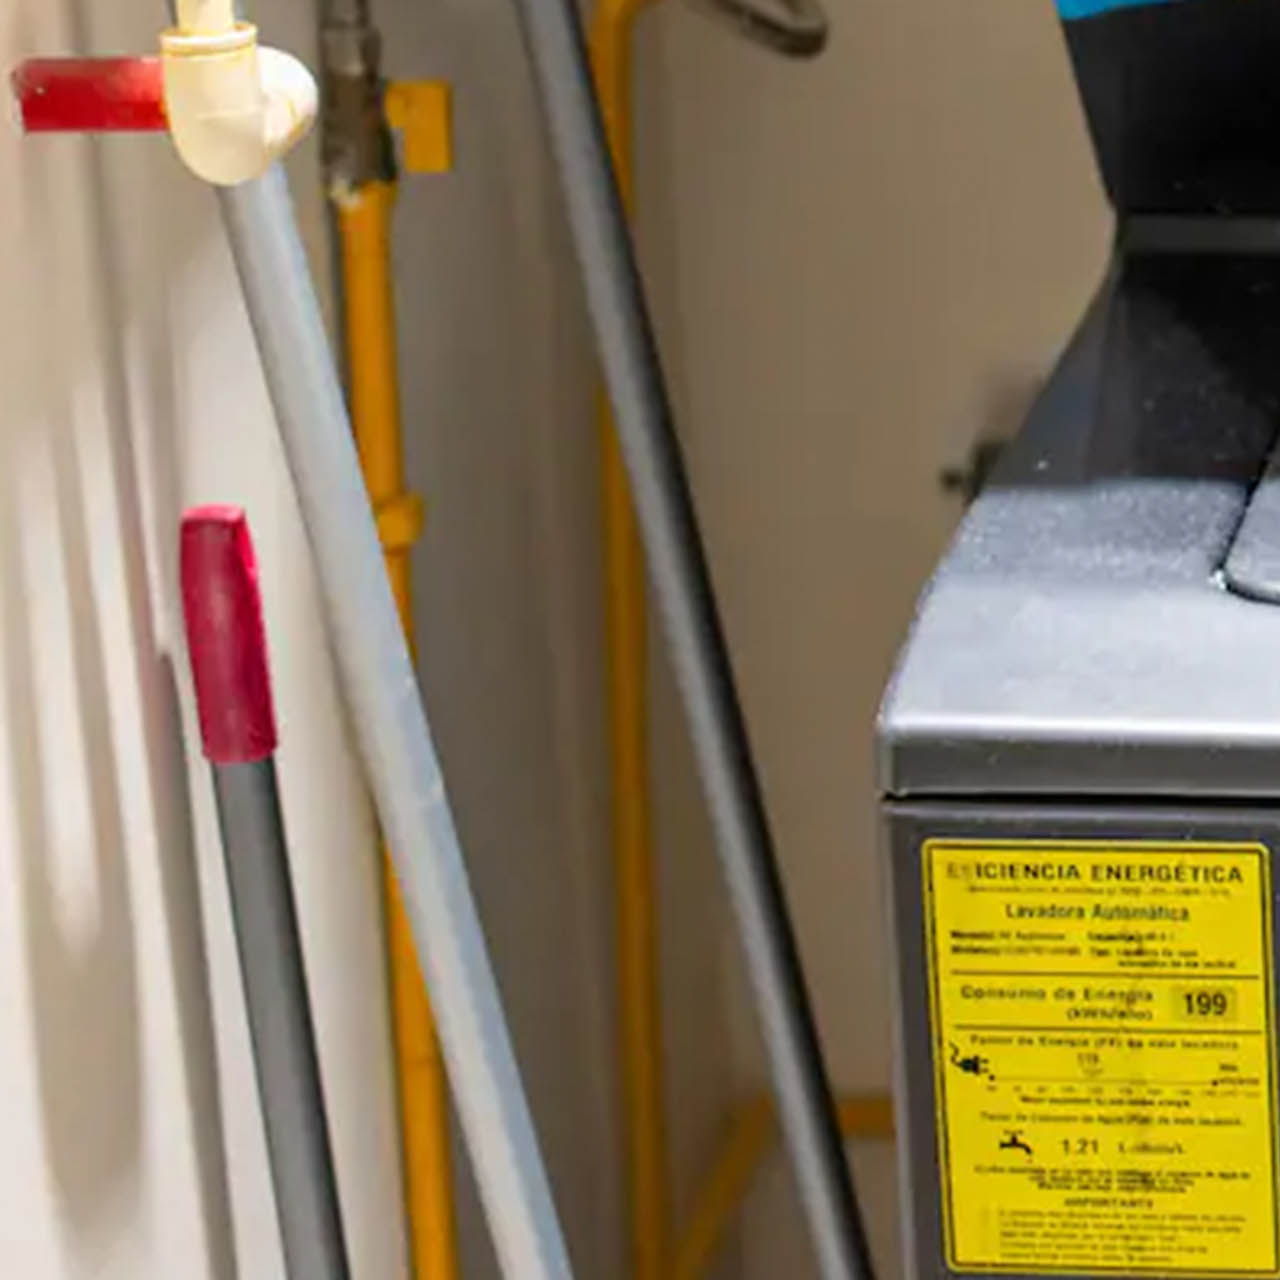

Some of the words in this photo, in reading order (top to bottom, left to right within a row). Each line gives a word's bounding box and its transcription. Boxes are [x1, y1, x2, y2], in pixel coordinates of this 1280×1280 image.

[1090, 862, 1244, 884] ENERGÉTICA
[1005, 903, 1085, 920] Lavadora
[961, 985, 1047, 1001] Consumo
[1053, 986, 1076, 1001] de
[1183, 992, 1229, 1016] 199
